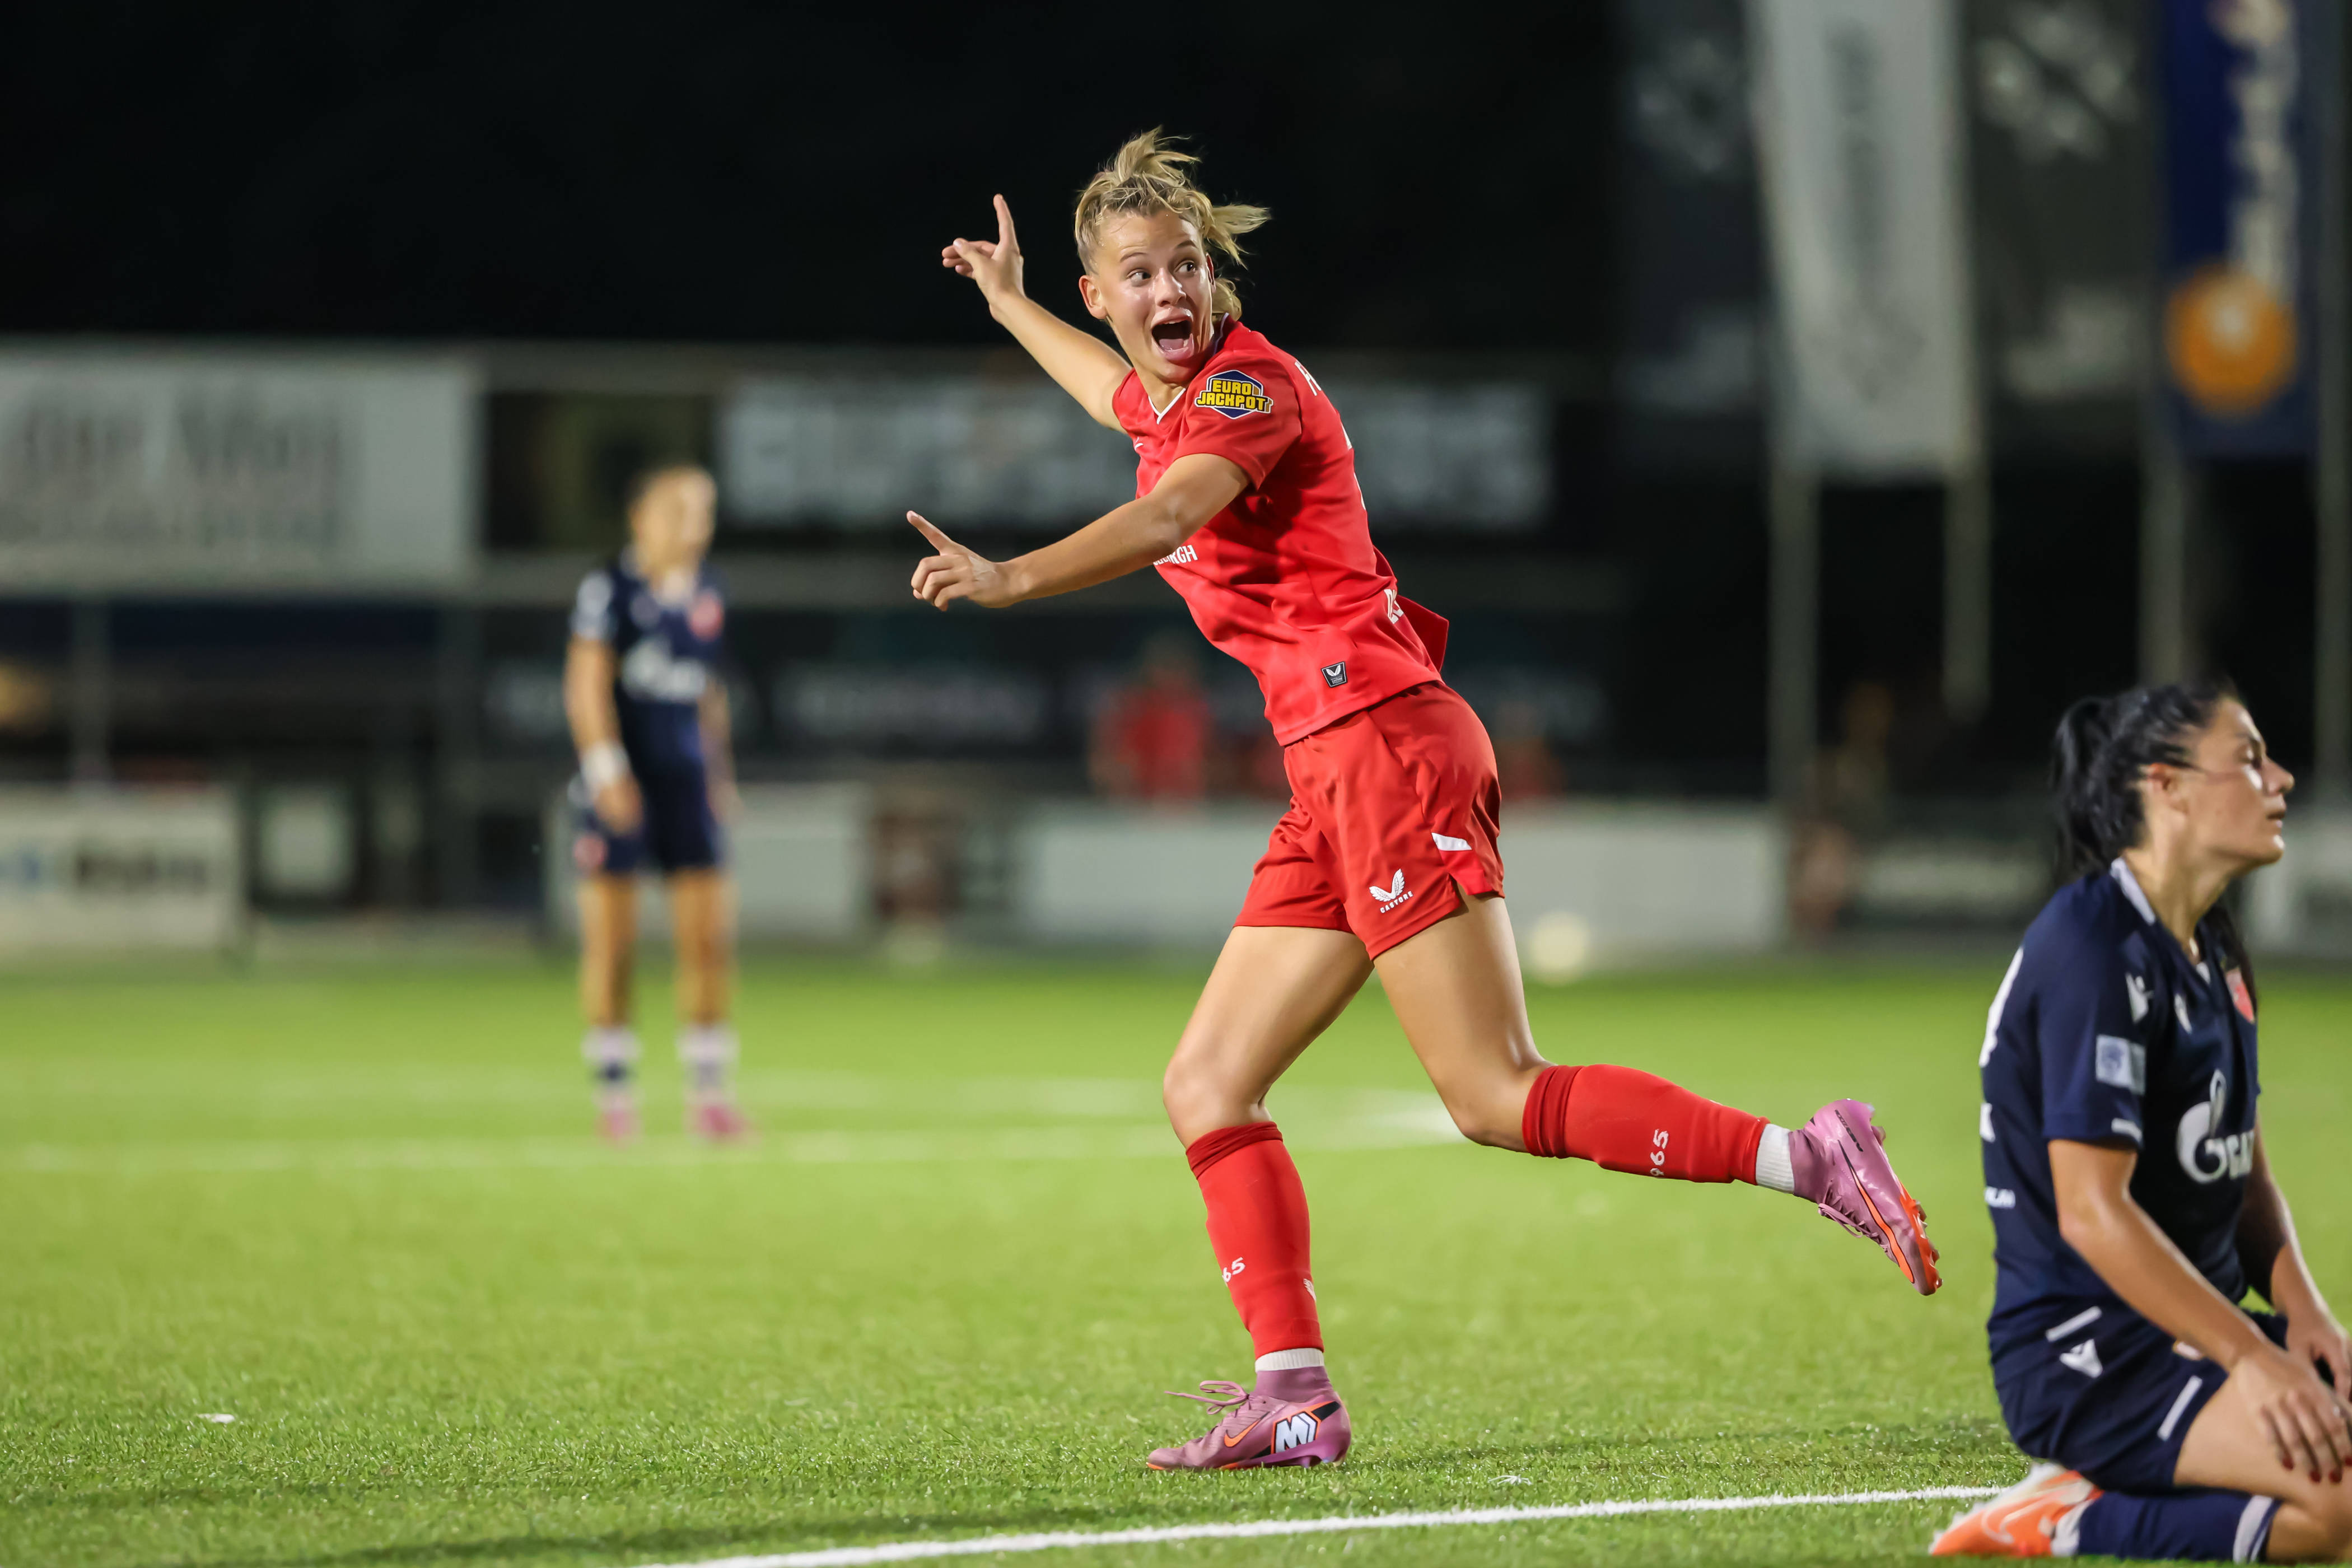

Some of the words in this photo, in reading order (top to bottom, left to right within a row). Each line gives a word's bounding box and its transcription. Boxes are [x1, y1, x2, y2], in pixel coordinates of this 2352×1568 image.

[1212, 380, 1252, 396] EURO
[1197, 392, 1266, 411] JACKPOT
[1380, 890, 1413, 913] CASTORE
